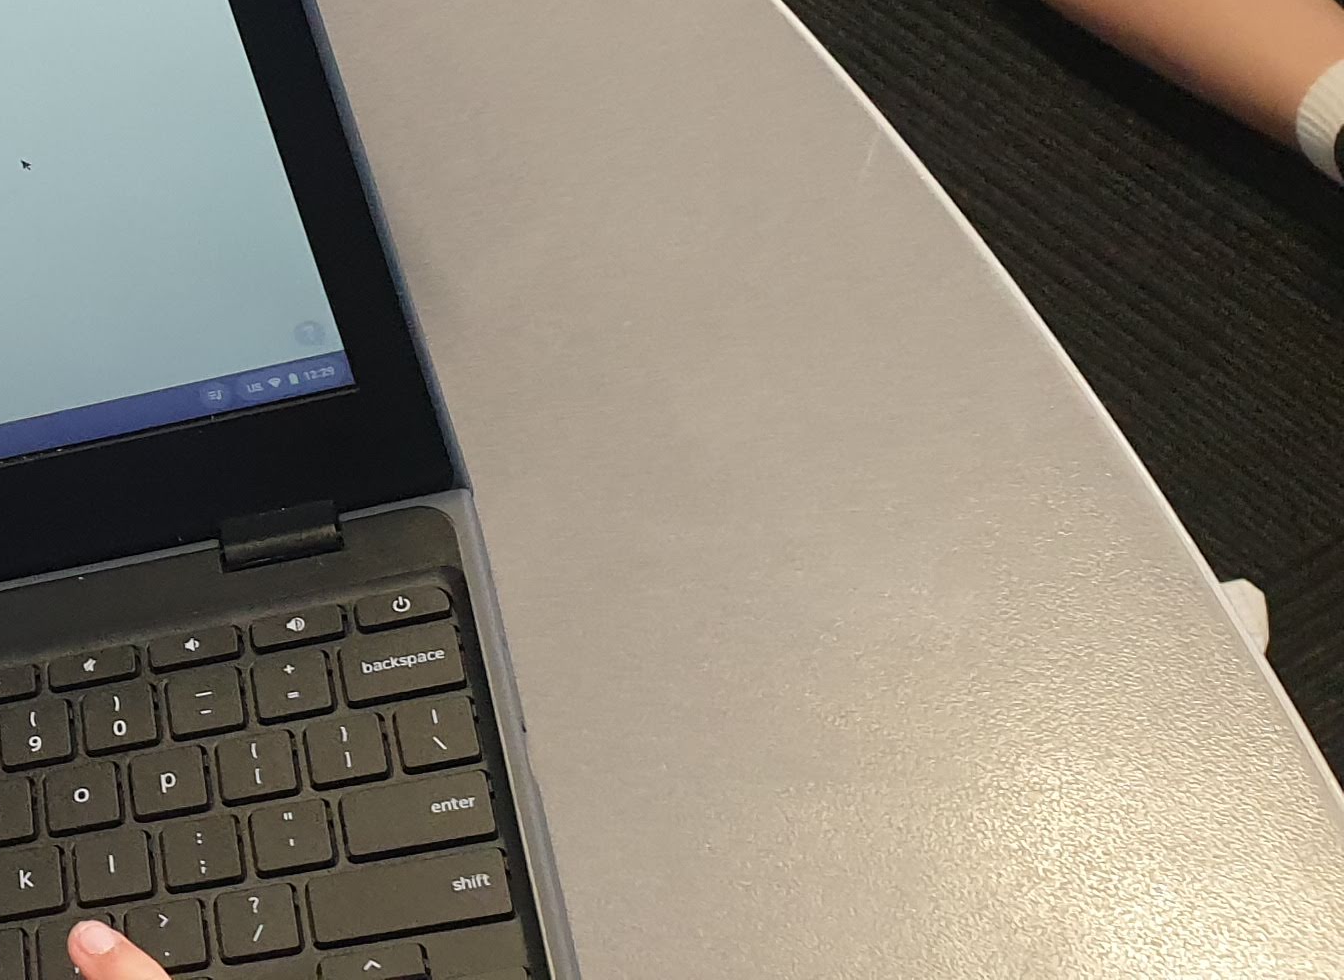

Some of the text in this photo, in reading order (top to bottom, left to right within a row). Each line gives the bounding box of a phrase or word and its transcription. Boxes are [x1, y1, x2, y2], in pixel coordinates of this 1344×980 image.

[246, 382, 265, 394] US
[359, 647, 446, 676] backspace
[111, 718, 127, 739] 0
[28, 734, 43, 754] 9
[159, 769, 178, 795] p
[72, 785, 90, 804] o
[429, 794, 476, 815] enter
[17, 867, 34, 888] k
[450, 872, 492, 894] shift
